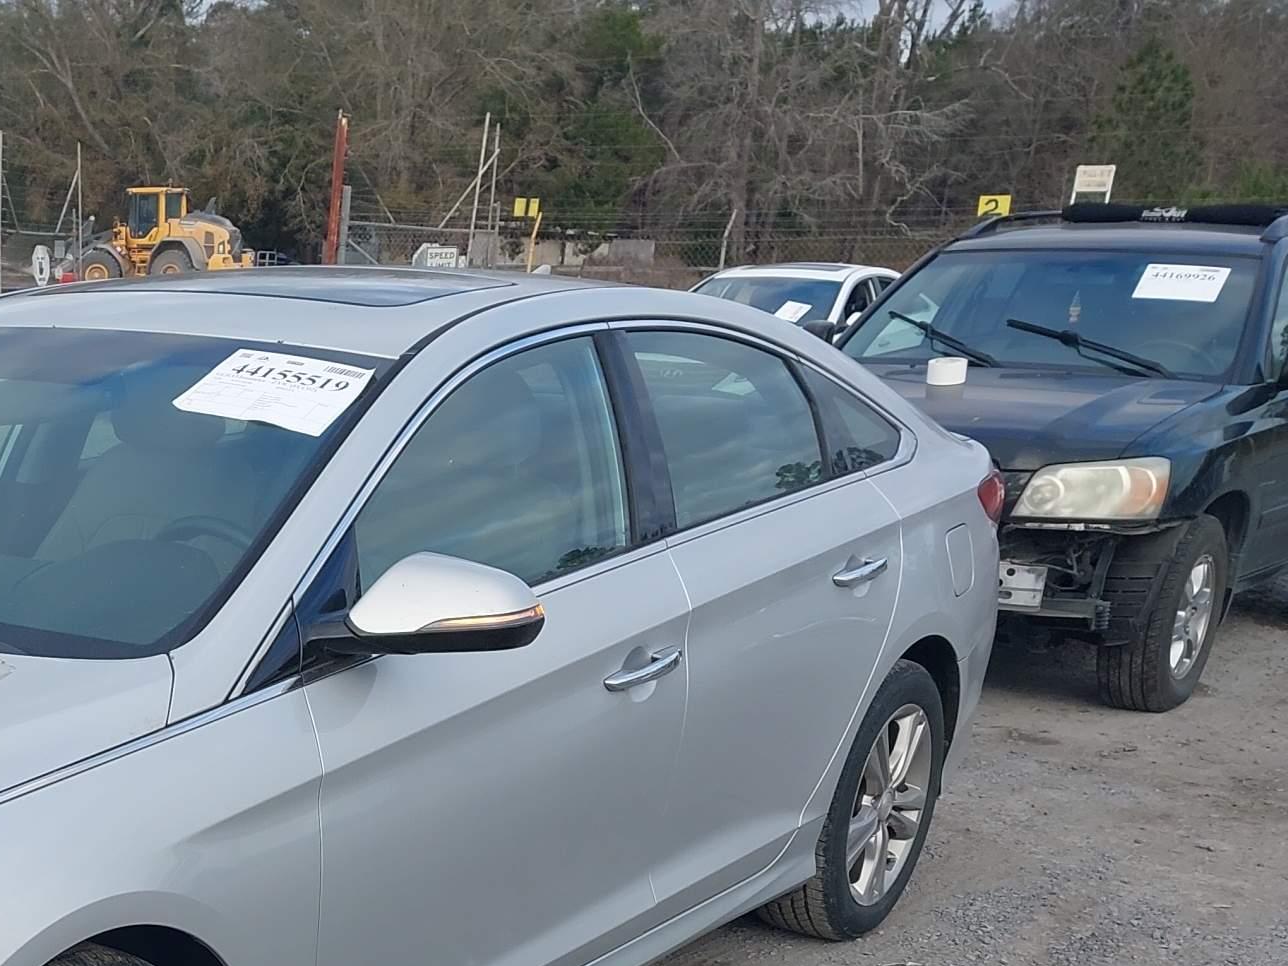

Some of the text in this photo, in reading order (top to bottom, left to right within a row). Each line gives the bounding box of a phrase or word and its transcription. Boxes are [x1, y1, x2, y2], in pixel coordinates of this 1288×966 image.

[983, 199, 1002, 216] 2
[429, 251, 455, 259] SPEED
[1151, 271, 1216, 281] 44169926
[232, 363, 350, 392] 44155519
